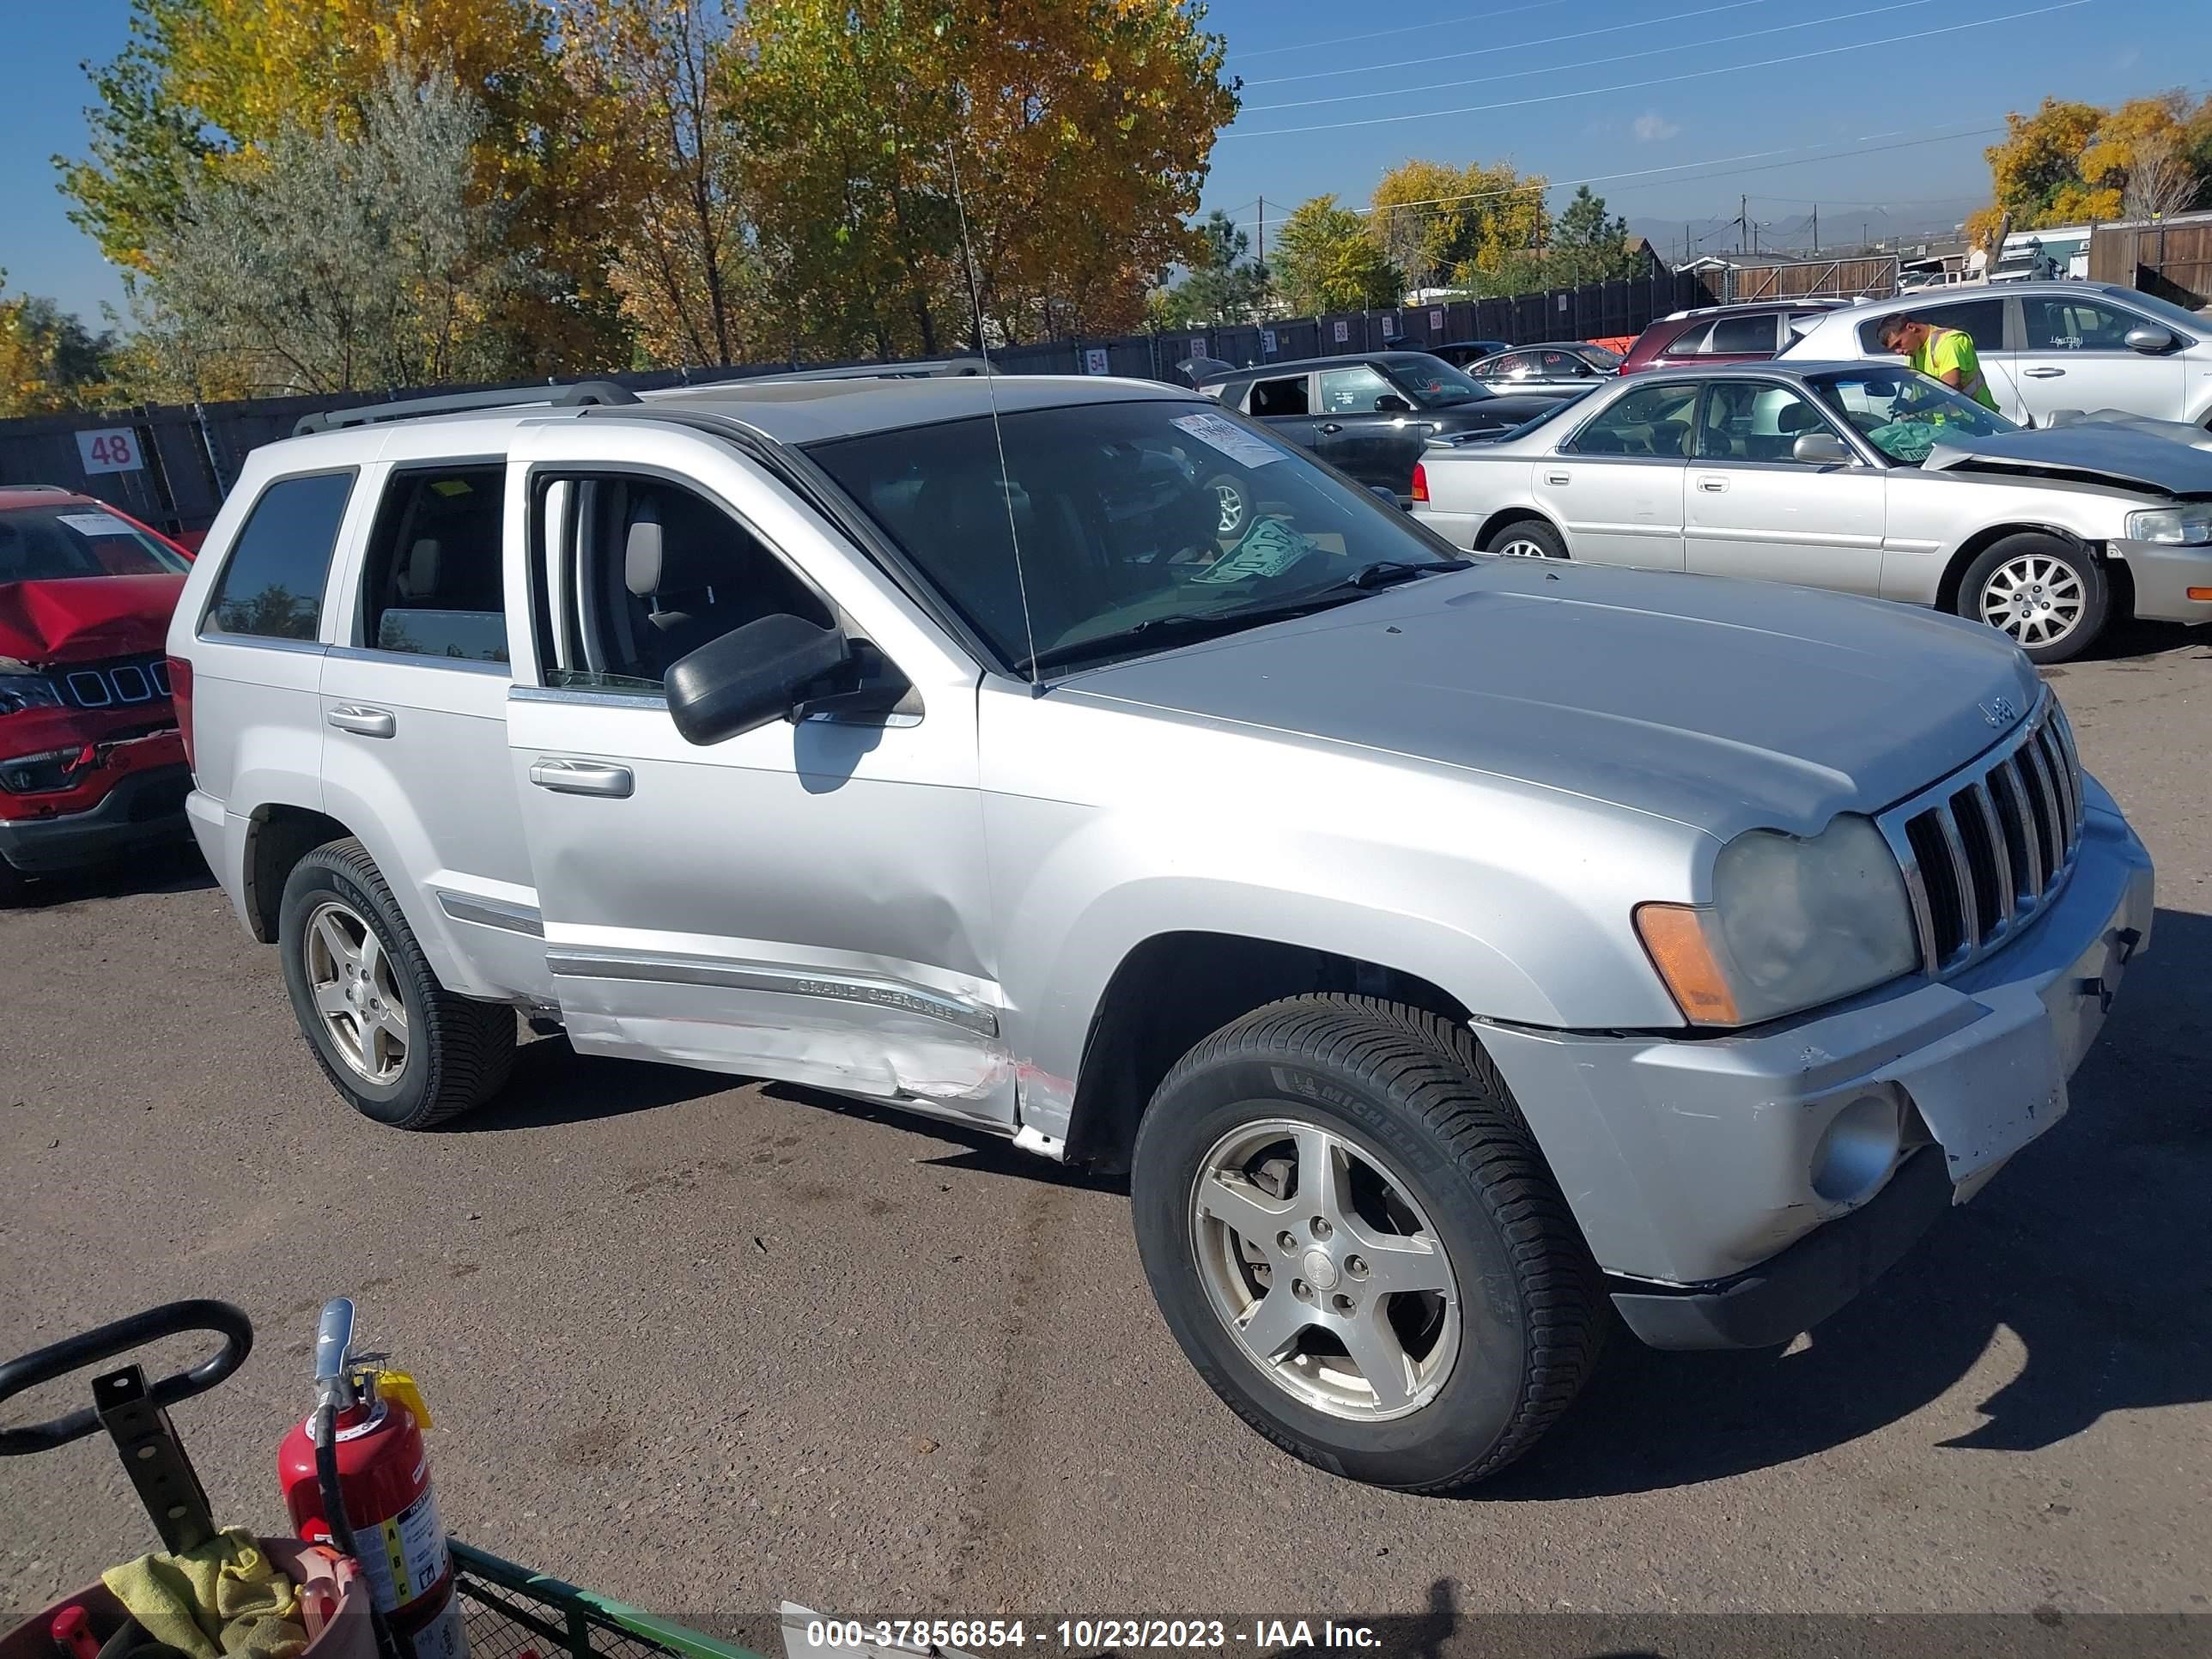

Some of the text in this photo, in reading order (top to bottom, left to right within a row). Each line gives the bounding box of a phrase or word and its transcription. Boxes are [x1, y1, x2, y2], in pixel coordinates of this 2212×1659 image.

[1091, 354, 1105, 371] 54
[90, 434, 131, 465] 48
[797, 980, 955, 1020] GRAND CHEROKEE
[1321, 1085, 1437, 1174] MICHELIN
